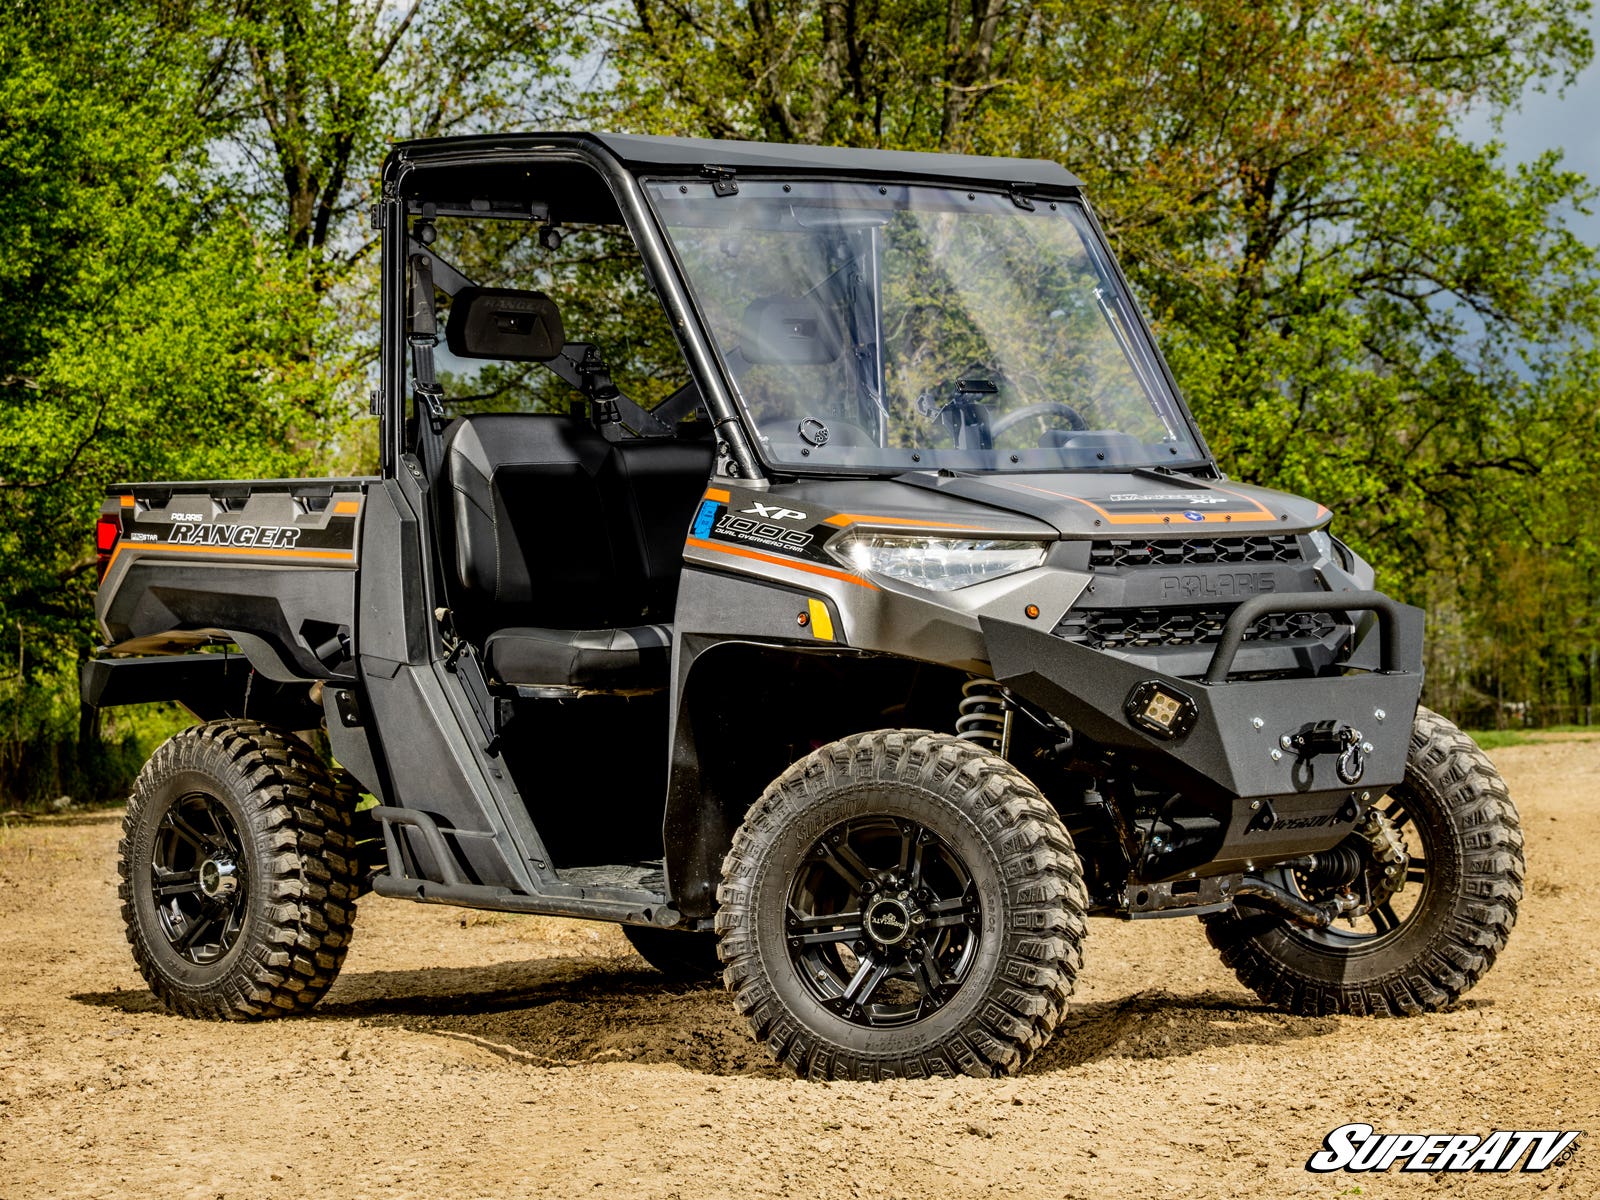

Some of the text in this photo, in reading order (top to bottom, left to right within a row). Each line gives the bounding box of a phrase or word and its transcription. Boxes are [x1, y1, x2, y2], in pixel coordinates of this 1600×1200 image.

[171, 513, 203, 522] POLARIS
[739, 501, 807, 520] XP
[168, 522, 300, 549] RANGER
[714, 528, 804, 553] DUAL OVERHEAD CAM
[716, 514, 814, 547] 1000
[1159, 572, 1276, 600] POLARIS
